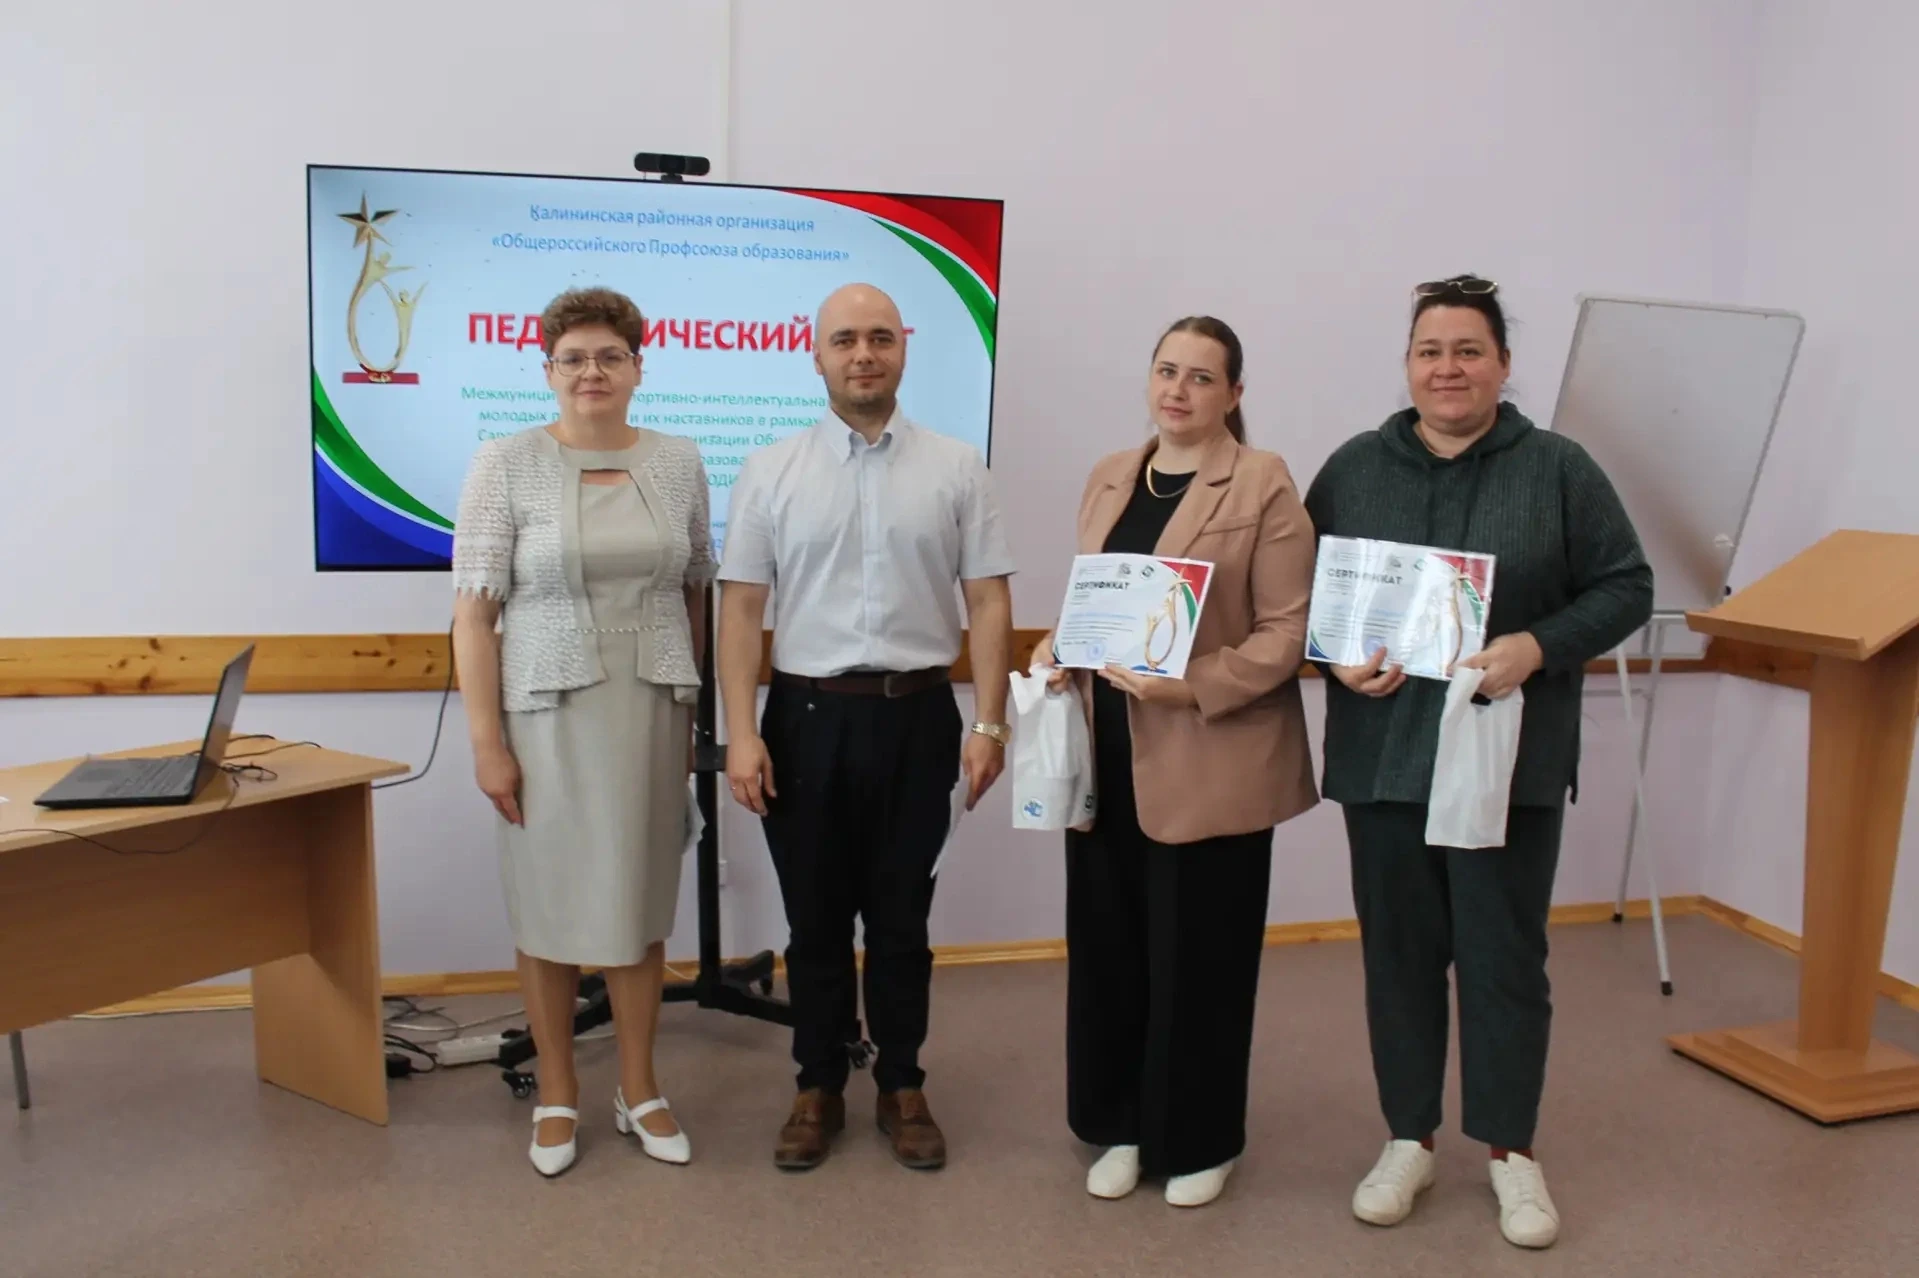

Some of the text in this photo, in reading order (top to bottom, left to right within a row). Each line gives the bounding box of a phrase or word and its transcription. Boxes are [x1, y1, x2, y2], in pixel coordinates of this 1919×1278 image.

[529, 204, 815, 233] Калининская районная организация
[492, 232, 850, 262] «Общероссийского Профсоюза образования»
[468, 313, 813, 353] ПЕДИЧЕСКИЙ
[479, 411, 548, 423] молодых
[643, 414, 660, 425] их
[664, 414, 755, 427] наставников
[758, 417, 766, 426] в
